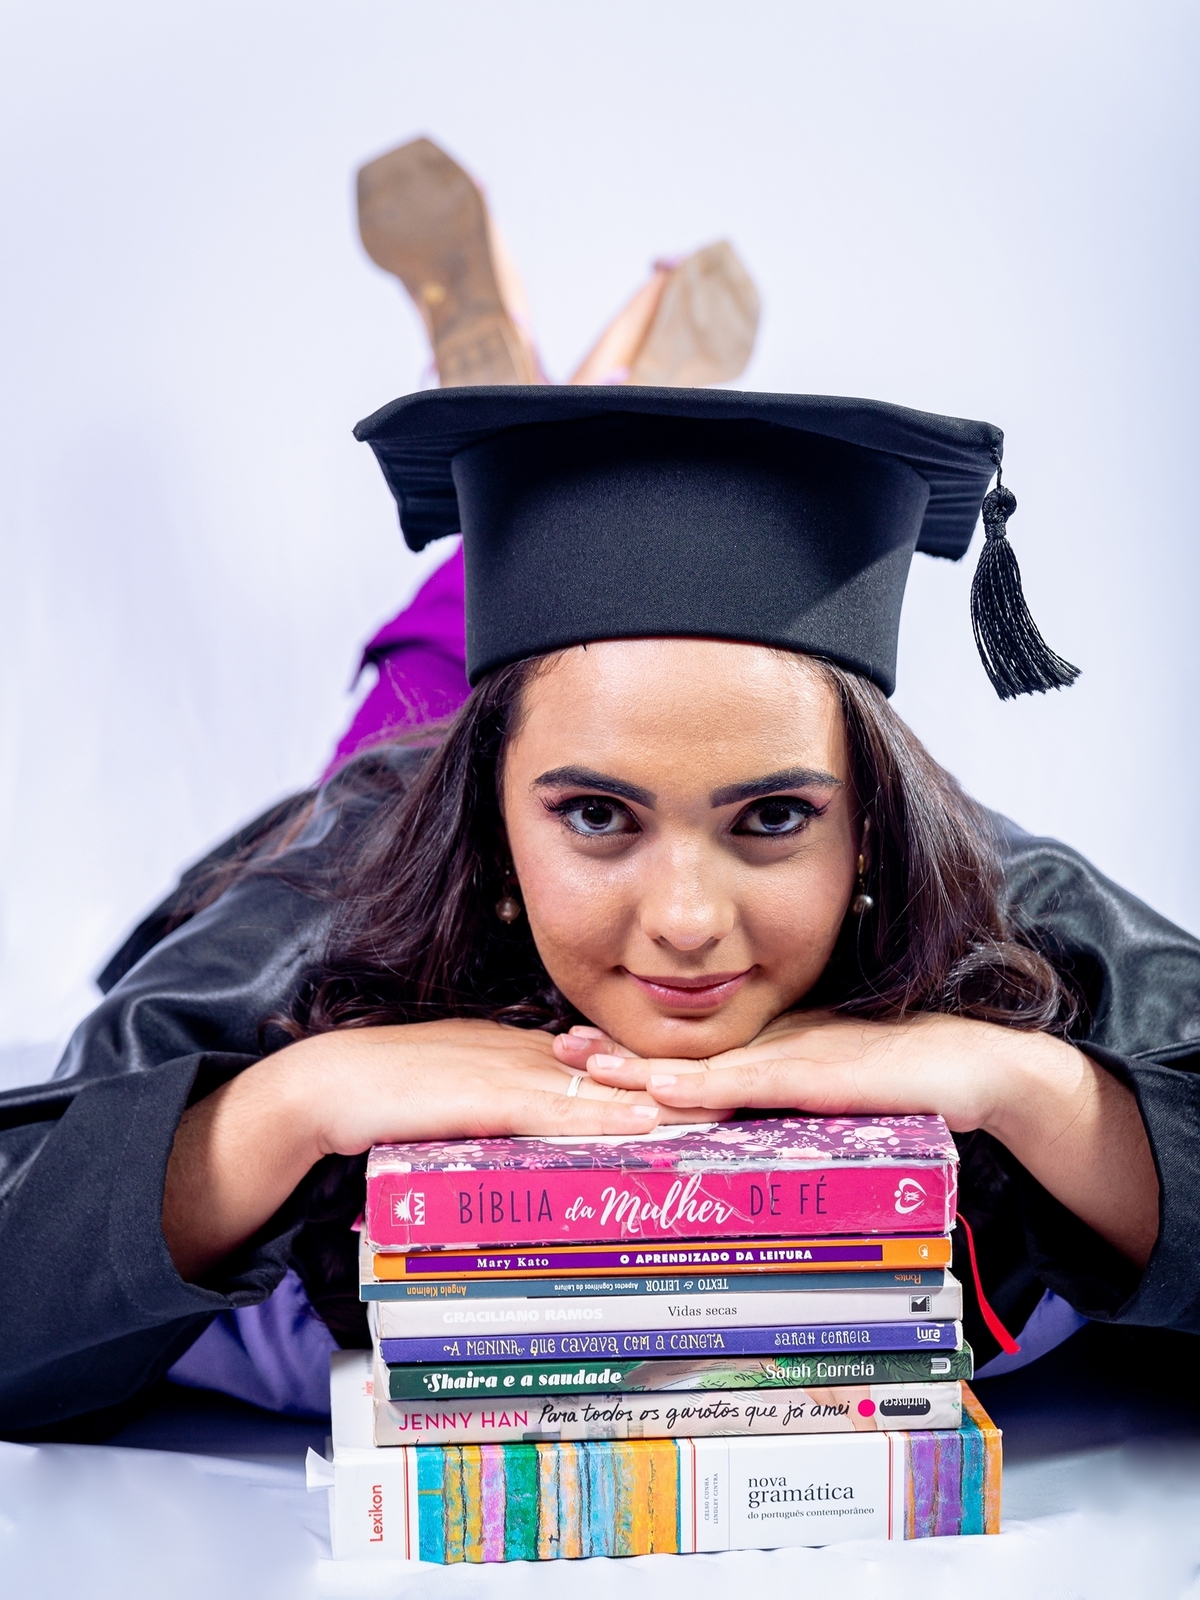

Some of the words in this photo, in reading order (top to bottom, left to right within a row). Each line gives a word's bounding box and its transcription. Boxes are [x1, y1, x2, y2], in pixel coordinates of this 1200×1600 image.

[413, 1192, 425, 1225] NVI
[459, 1182, 553, 1224] BÍBLIA
[565, 1196, 596, 1222] da
[600, 1172, 735, 1234] Mulher
[750, 1184, 782, 1216] DE
[799, 1175, 828, 1215] FÉ
[477, 1257, 512, 1269] Mary
[517, 1256, 550, 1268] Kato
[620, 1253, 630, 1265] O
[635, 1250, 731, 1265] APRENDIZADO
[735, 1250, 755, 1262] DA
[759, 1249, 813, 1262] LEITURA
[615, 1281, 639, 1291] Aspectos
[645, 1278, 680, 1292] LEITOR
[683, 1280, 694, 1290] &
[697, 1277, 729, 1291] TEXTO
[894, 1274, 922, 1285] Pontes
[406, 1284, 439, 1296] Kleiman
[441, 1283, 467, 1297] Angela
[554, 1283, 574, 1292] Leitura
[574, 1283, 583, 1292] da
[583, 1282, 615, 1292] Cognitivos
[442, 1309, 540, 1324] GRACILIANO
[545, 1307, 603, 1321] RAMOS
[668, 1305, 702, 1317] Vidas
[705, 1306, 738, 1316] secas
[916, 1327, 941, 1340] lura
[442, 1341, 461, 1356] A
[765, 1363, 811, 1380] Sarah
[816, 1361, 875, 1378] Correia
[422, 1370, 498, 1393] Shaira
[503, 1374, 515, 1387] e
[520, 1374, 533, 1387] a
[538, 1368, 622, 1386] saudade
[883, 1397, 927, 1409] intrínseca
[399, 1412, 473, 1431] JENNY
[481, 1410, 528, 1428] HAN
[537, 1403, 578, 1425] Para
[581, 1403, 633, 1422] todos
[639, 1409, 660, 1421] os
[665, 1400, 740, 1429] garotos
[744, 1406, 778, 1426] que
[782, 1401, 804, 1426] já
[810, 1400, 851, 1417] amei
[747, 1475, 787, 1488] nova
[747, 1483, 855, 1508] gramática
[368, 1484, 384, 1543] Lexikon
[747, 1509, 759, 1520] do
[760, 1507, 805, 1521] português
[805, 1505, 875, 1520] contemporâneo
